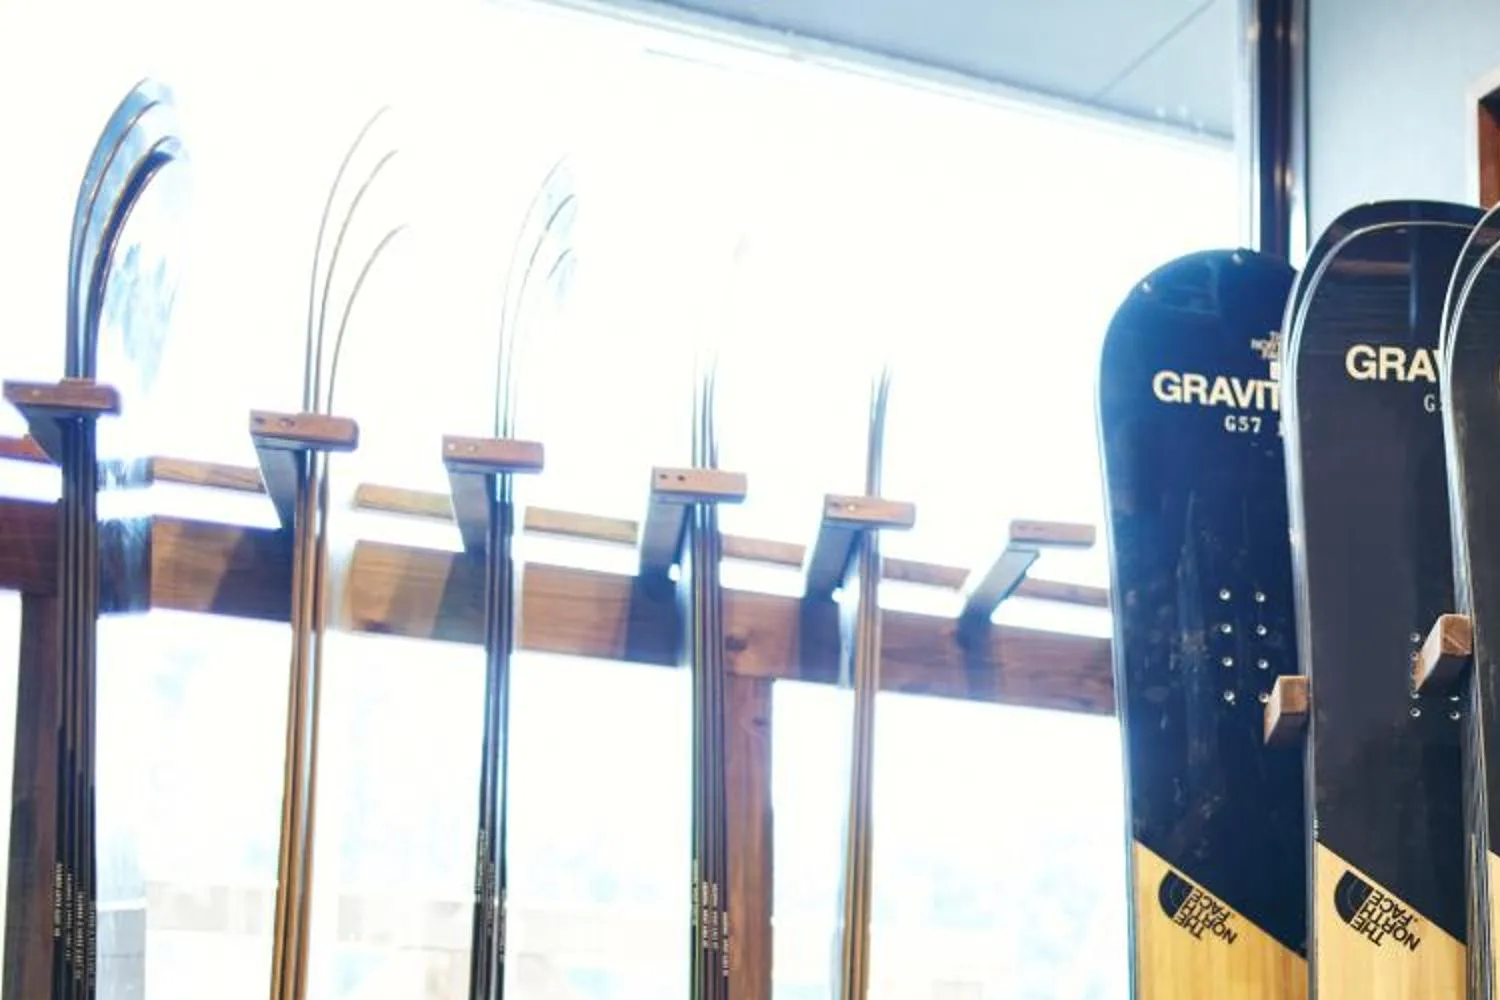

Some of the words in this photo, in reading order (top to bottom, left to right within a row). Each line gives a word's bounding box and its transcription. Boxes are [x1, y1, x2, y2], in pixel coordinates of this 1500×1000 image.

[1345, 343, 1440, 383] GRA
[1224, 414, 1262, 433] G57
[1369, 890, 1413, 926] FACE
[1350, 915, 1384, 946] THE
[1360, 903, 1421, 951] NORTH
